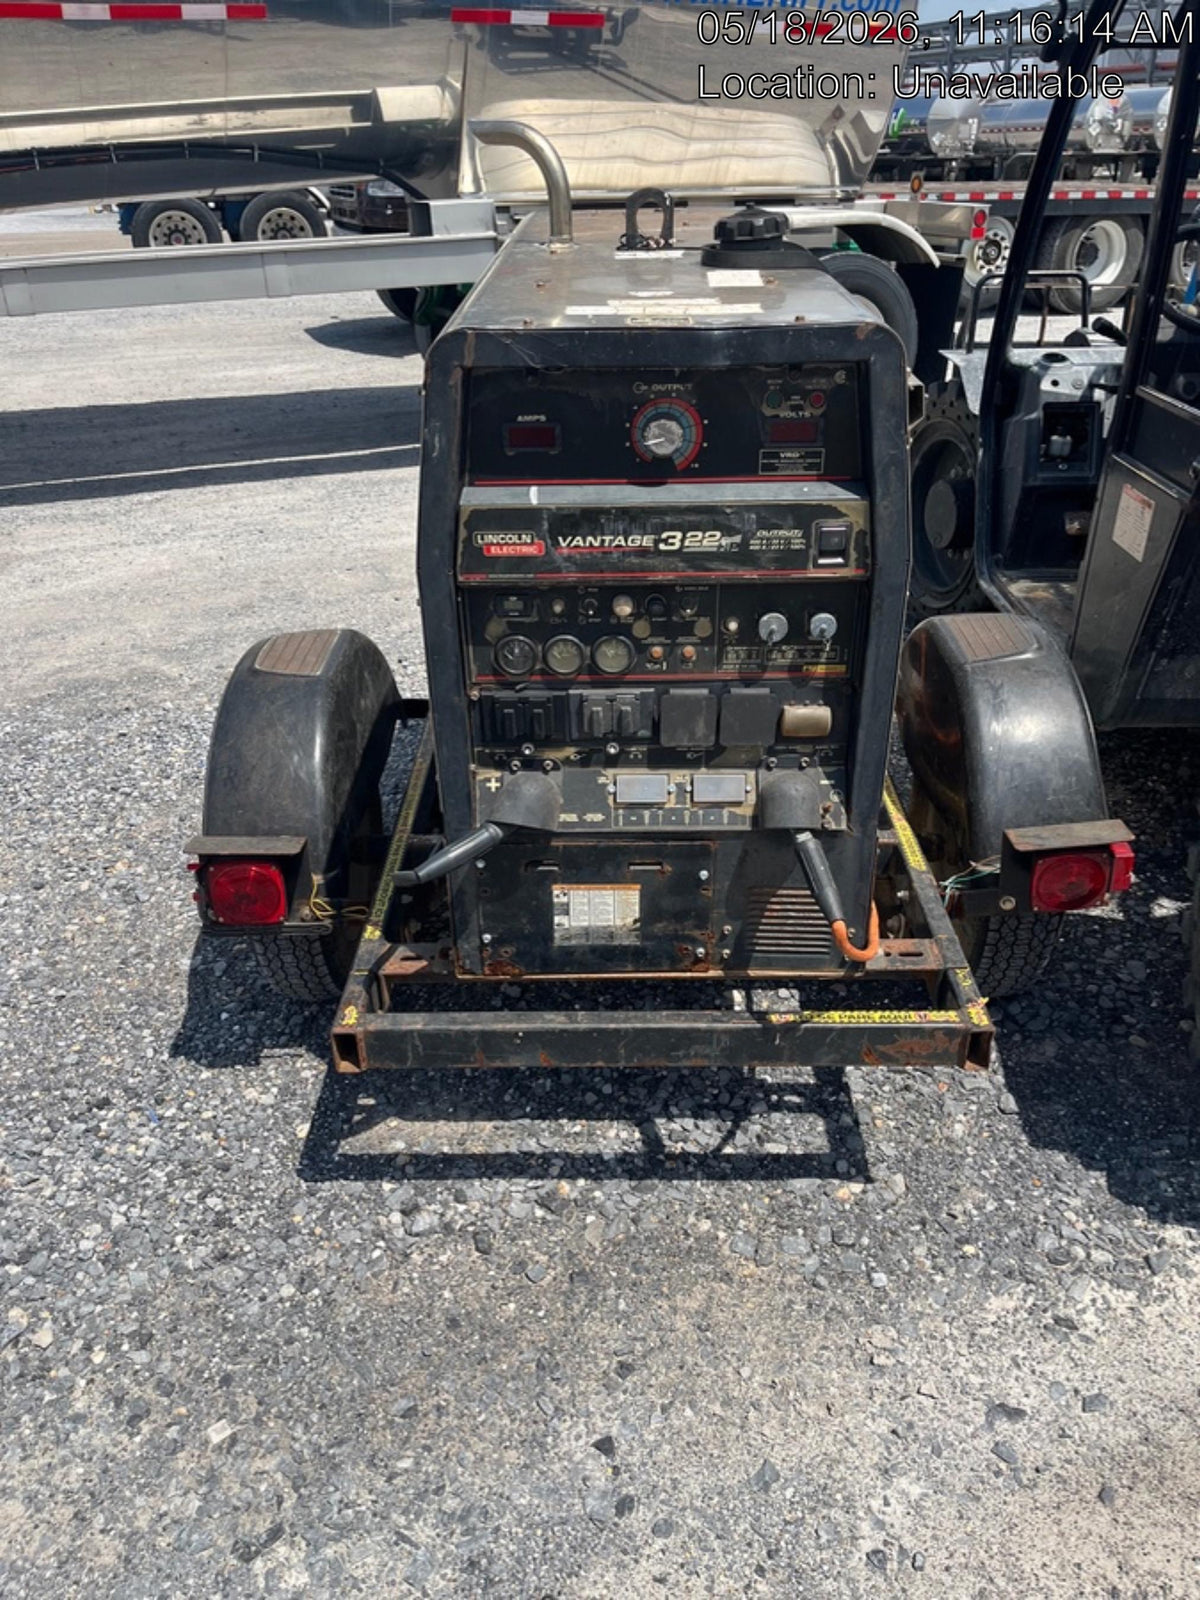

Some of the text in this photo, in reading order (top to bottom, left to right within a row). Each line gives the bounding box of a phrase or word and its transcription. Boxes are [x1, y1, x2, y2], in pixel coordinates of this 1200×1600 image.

[516, 414, 547, 422] AMPS
[476, 533, 532, 545] LINCOLN
[557, 535, 655, 547] VANTAGE
[658, 530, 721, 551] 322
[490, 545, 539, 555] ELECTRIC
